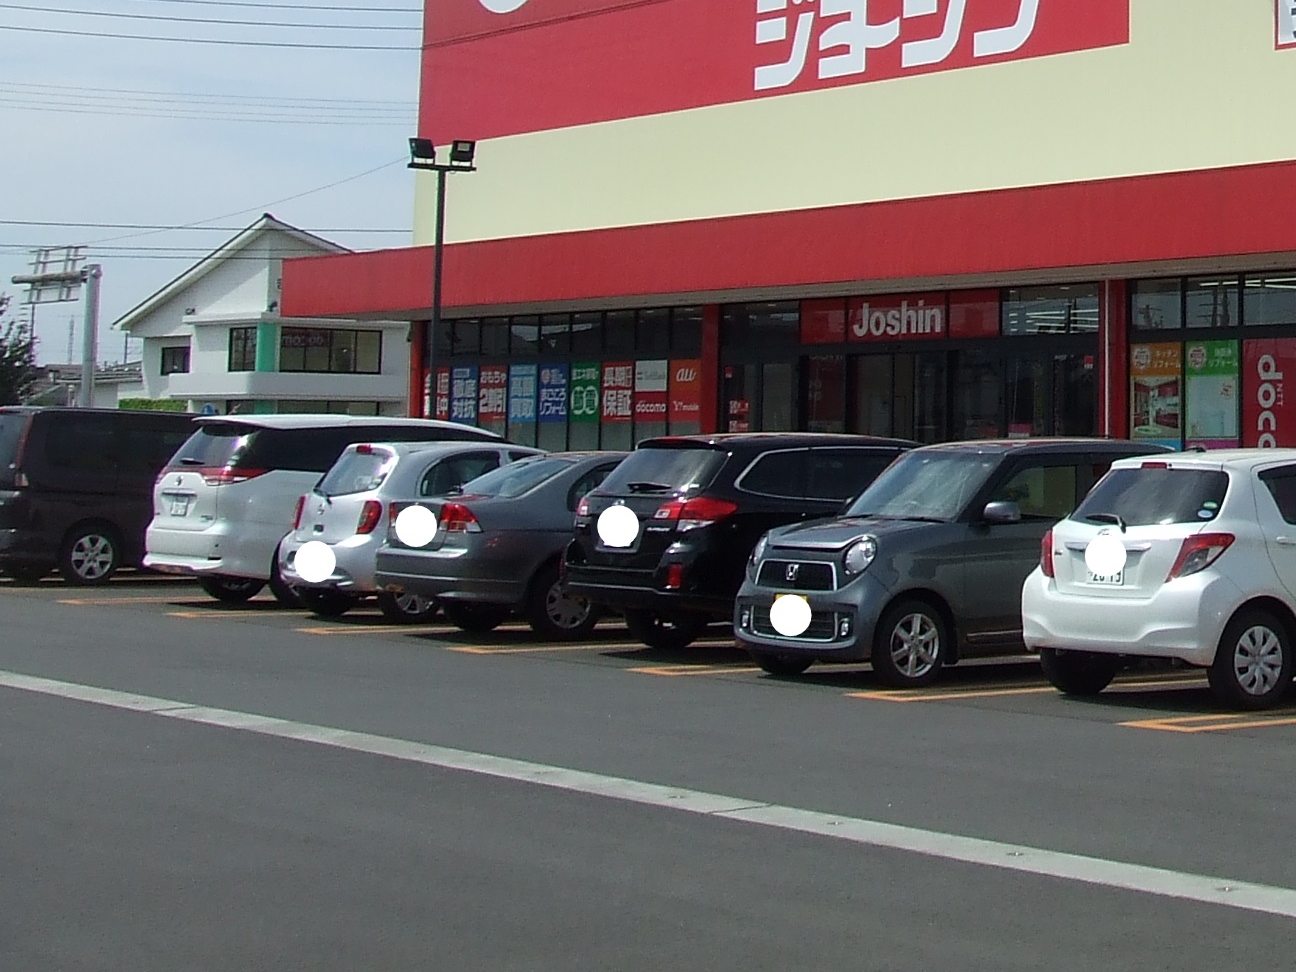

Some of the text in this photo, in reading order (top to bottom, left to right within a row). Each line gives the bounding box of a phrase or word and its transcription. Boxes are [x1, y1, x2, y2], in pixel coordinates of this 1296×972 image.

[853, 299, 942, 338] Joshin
[676, 368, 697, 382] au
[1276, 383, 1284, 407] NTT
[635, 400, 666, 412] docomo
